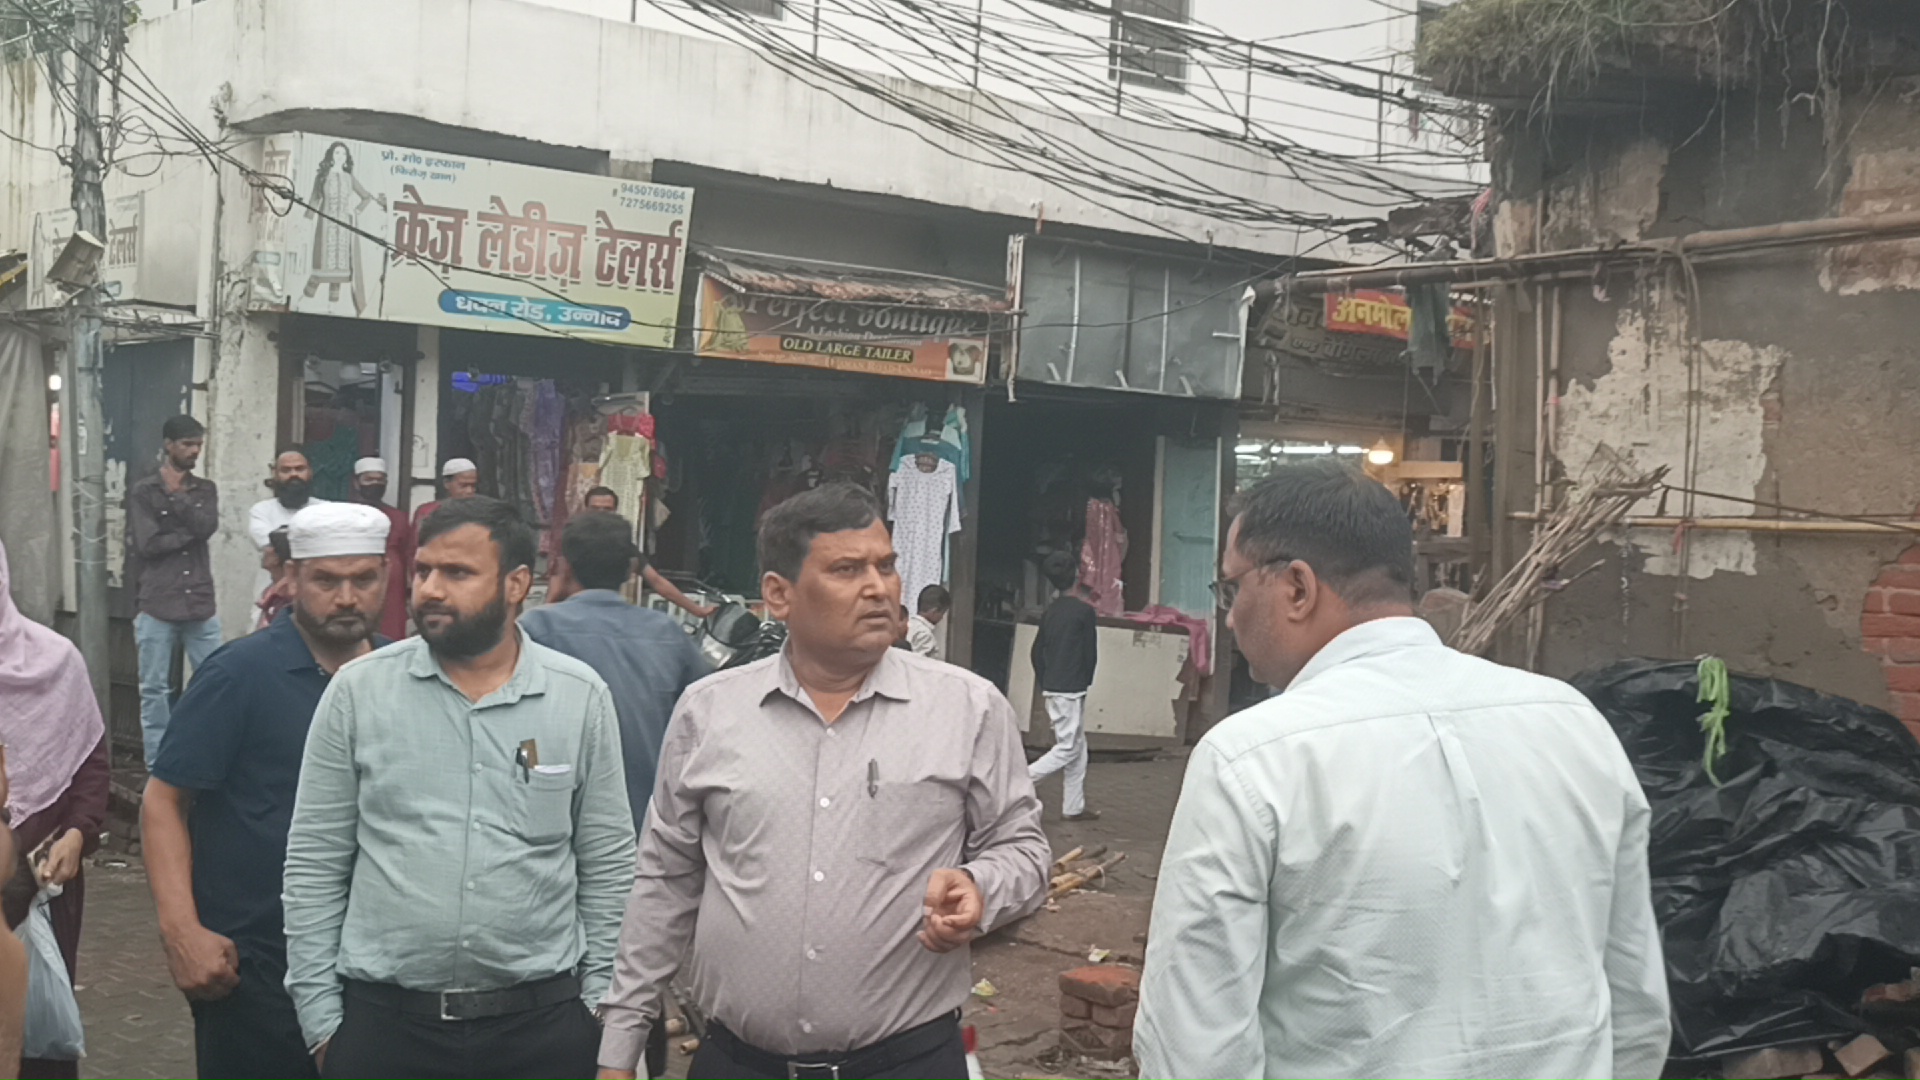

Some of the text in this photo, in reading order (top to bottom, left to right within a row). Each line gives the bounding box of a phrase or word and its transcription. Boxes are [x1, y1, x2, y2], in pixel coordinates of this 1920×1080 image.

[594, 209, 684, 294] टेलर्स
[1332, 295, 1413, 332] अनमोल
[783, 337, 912, 362] OLD LARGE TAILER
